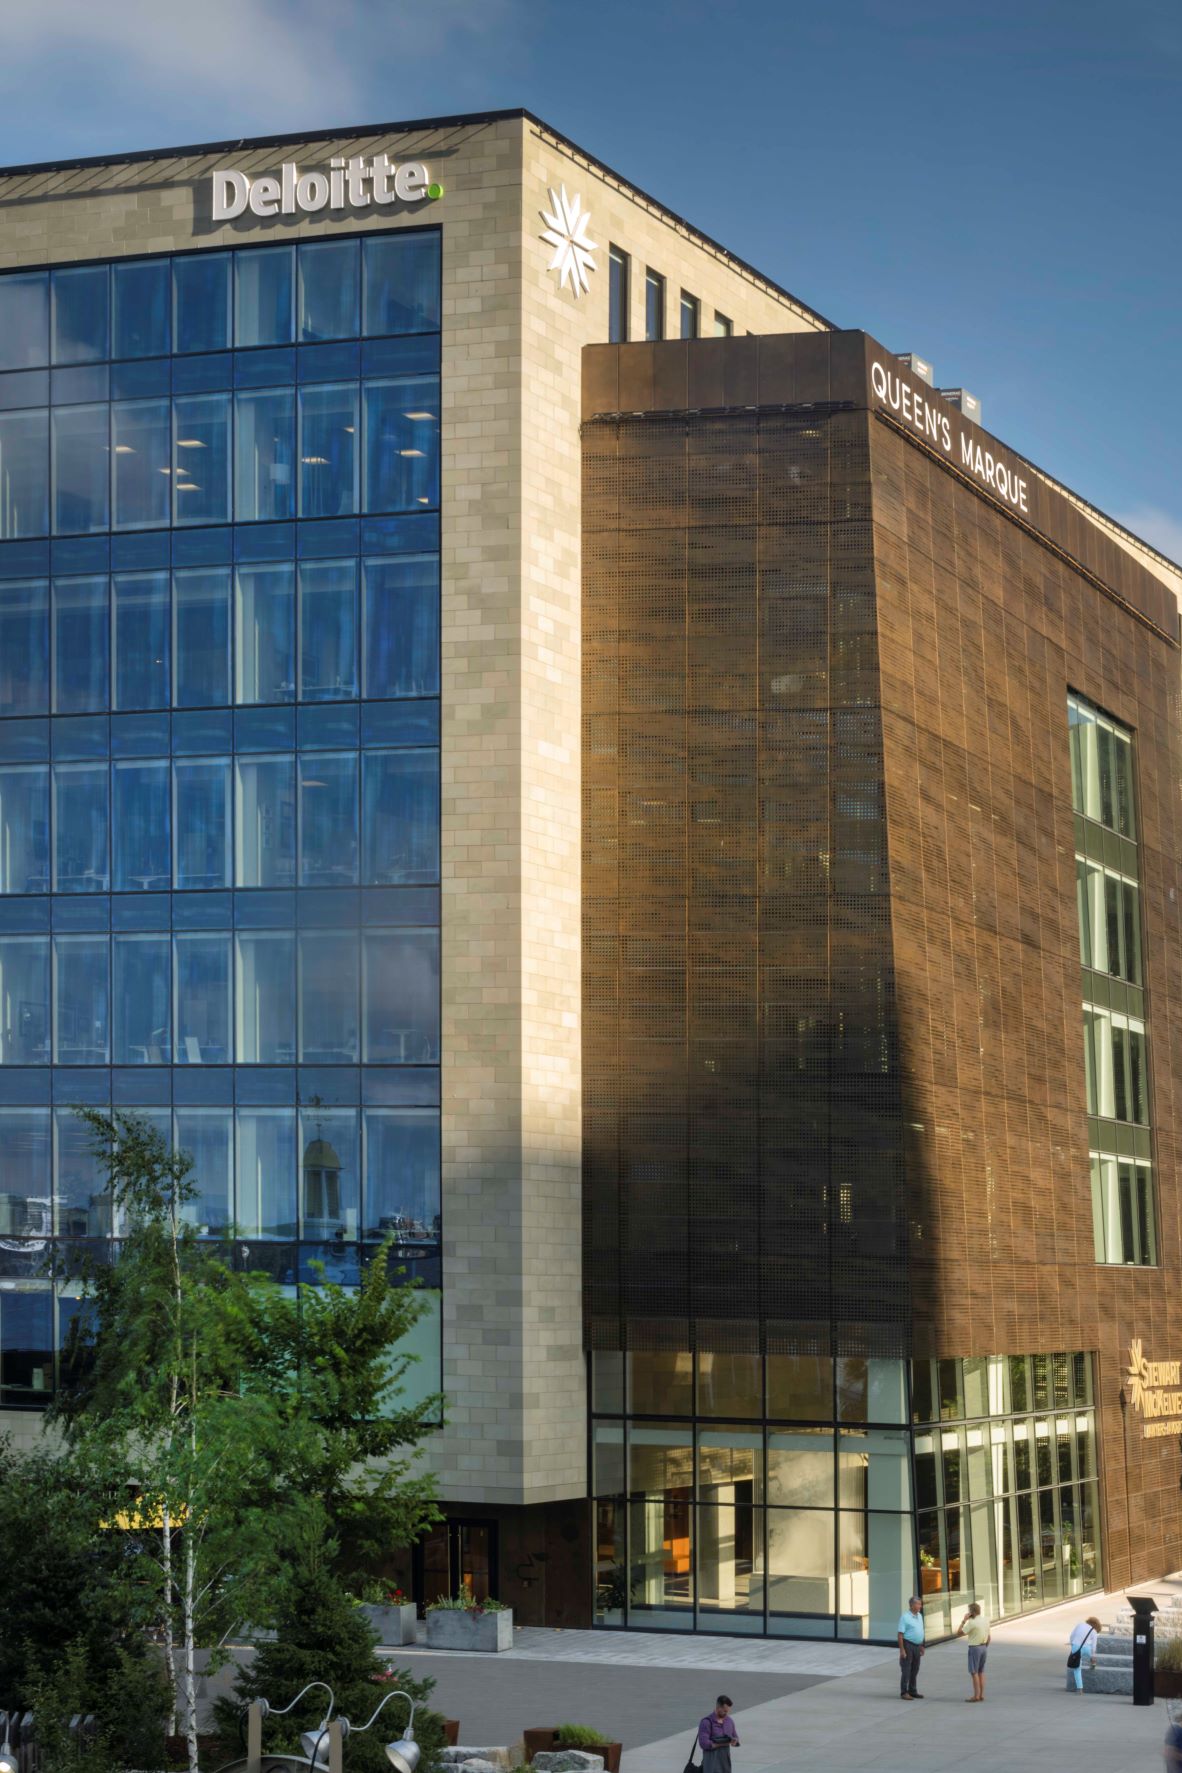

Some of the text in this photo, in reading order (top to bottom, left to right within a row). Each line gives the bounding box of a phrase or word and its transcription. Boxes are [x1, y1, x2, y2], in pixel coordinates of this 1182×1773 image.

[871, 361, 1028, 512] QUEEN'S MARQUE
[1141, 1358, 1181, 1389] STEWART
